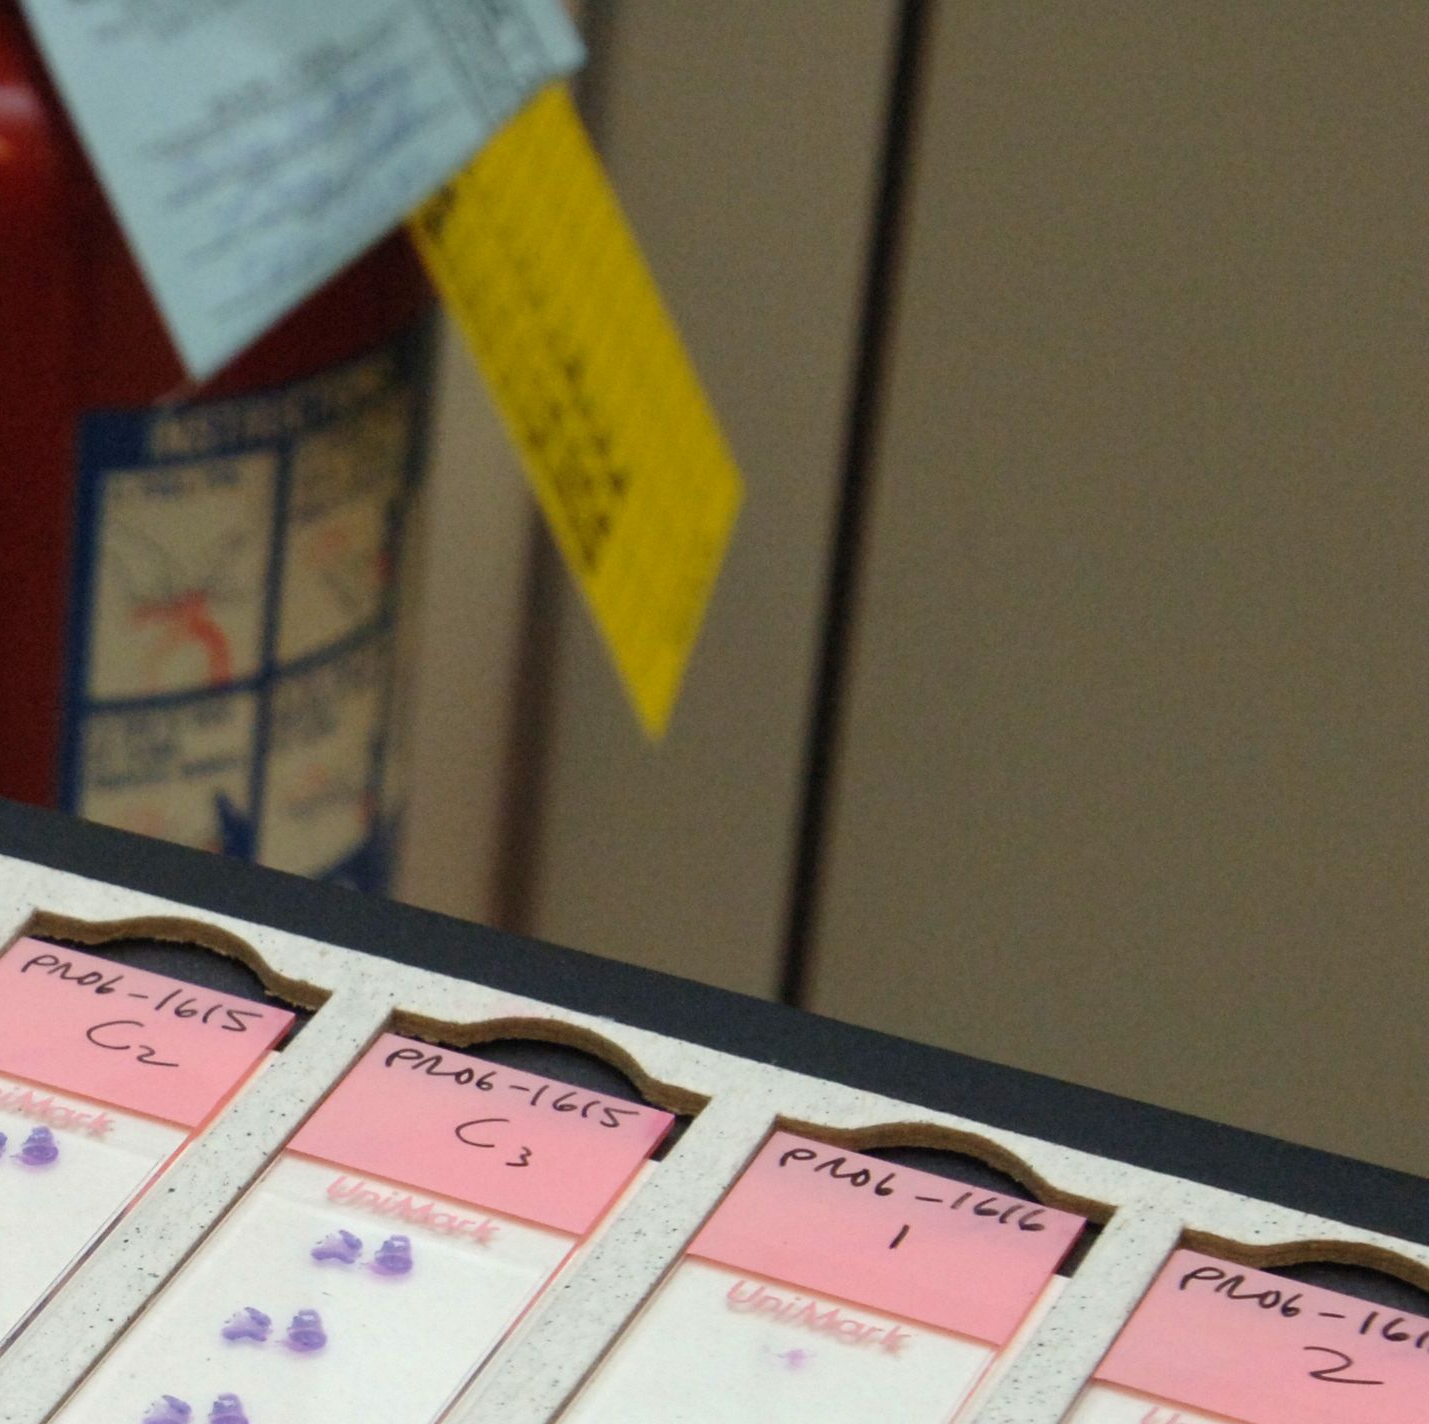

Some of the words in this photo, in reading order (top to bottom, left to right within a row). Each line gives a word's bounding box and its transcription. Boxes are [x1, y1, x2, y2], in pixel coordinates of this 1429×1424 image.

[325, 1174, 501, 1246] UniMark
[887, 1223, 911, 1250] 1
[726, 1279, 912, 1357] UniMark
[1302, 1346, 1386, 1385] 2
